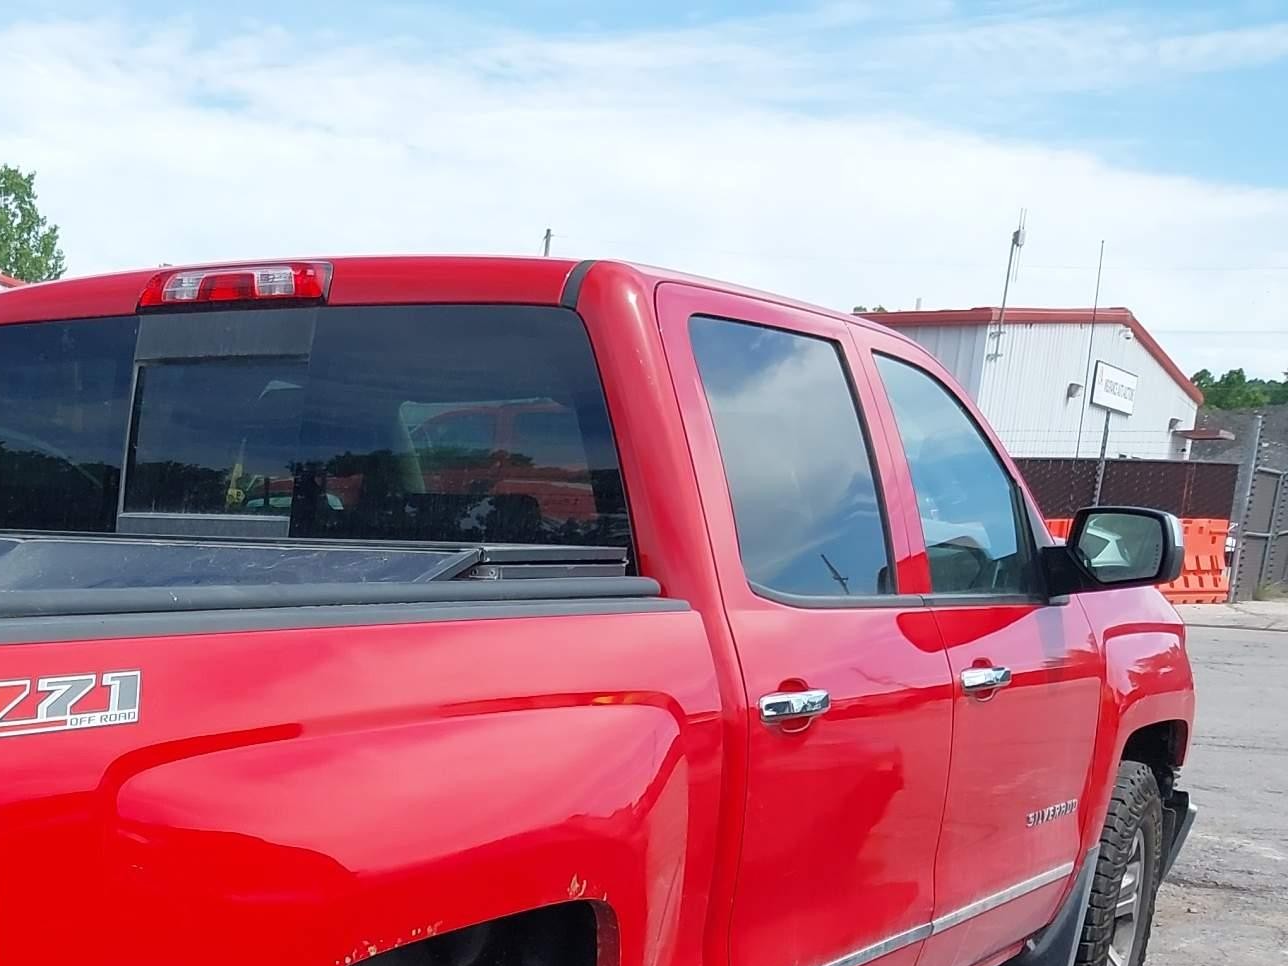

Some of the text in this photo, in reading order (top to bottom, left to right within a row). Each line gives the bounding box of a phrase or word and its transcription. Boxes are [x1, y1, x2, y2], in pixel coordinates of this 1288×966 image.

[69, 711, 136, 727] OFF ROAD
[1025, 799, 1078, 828] SILVERADO
